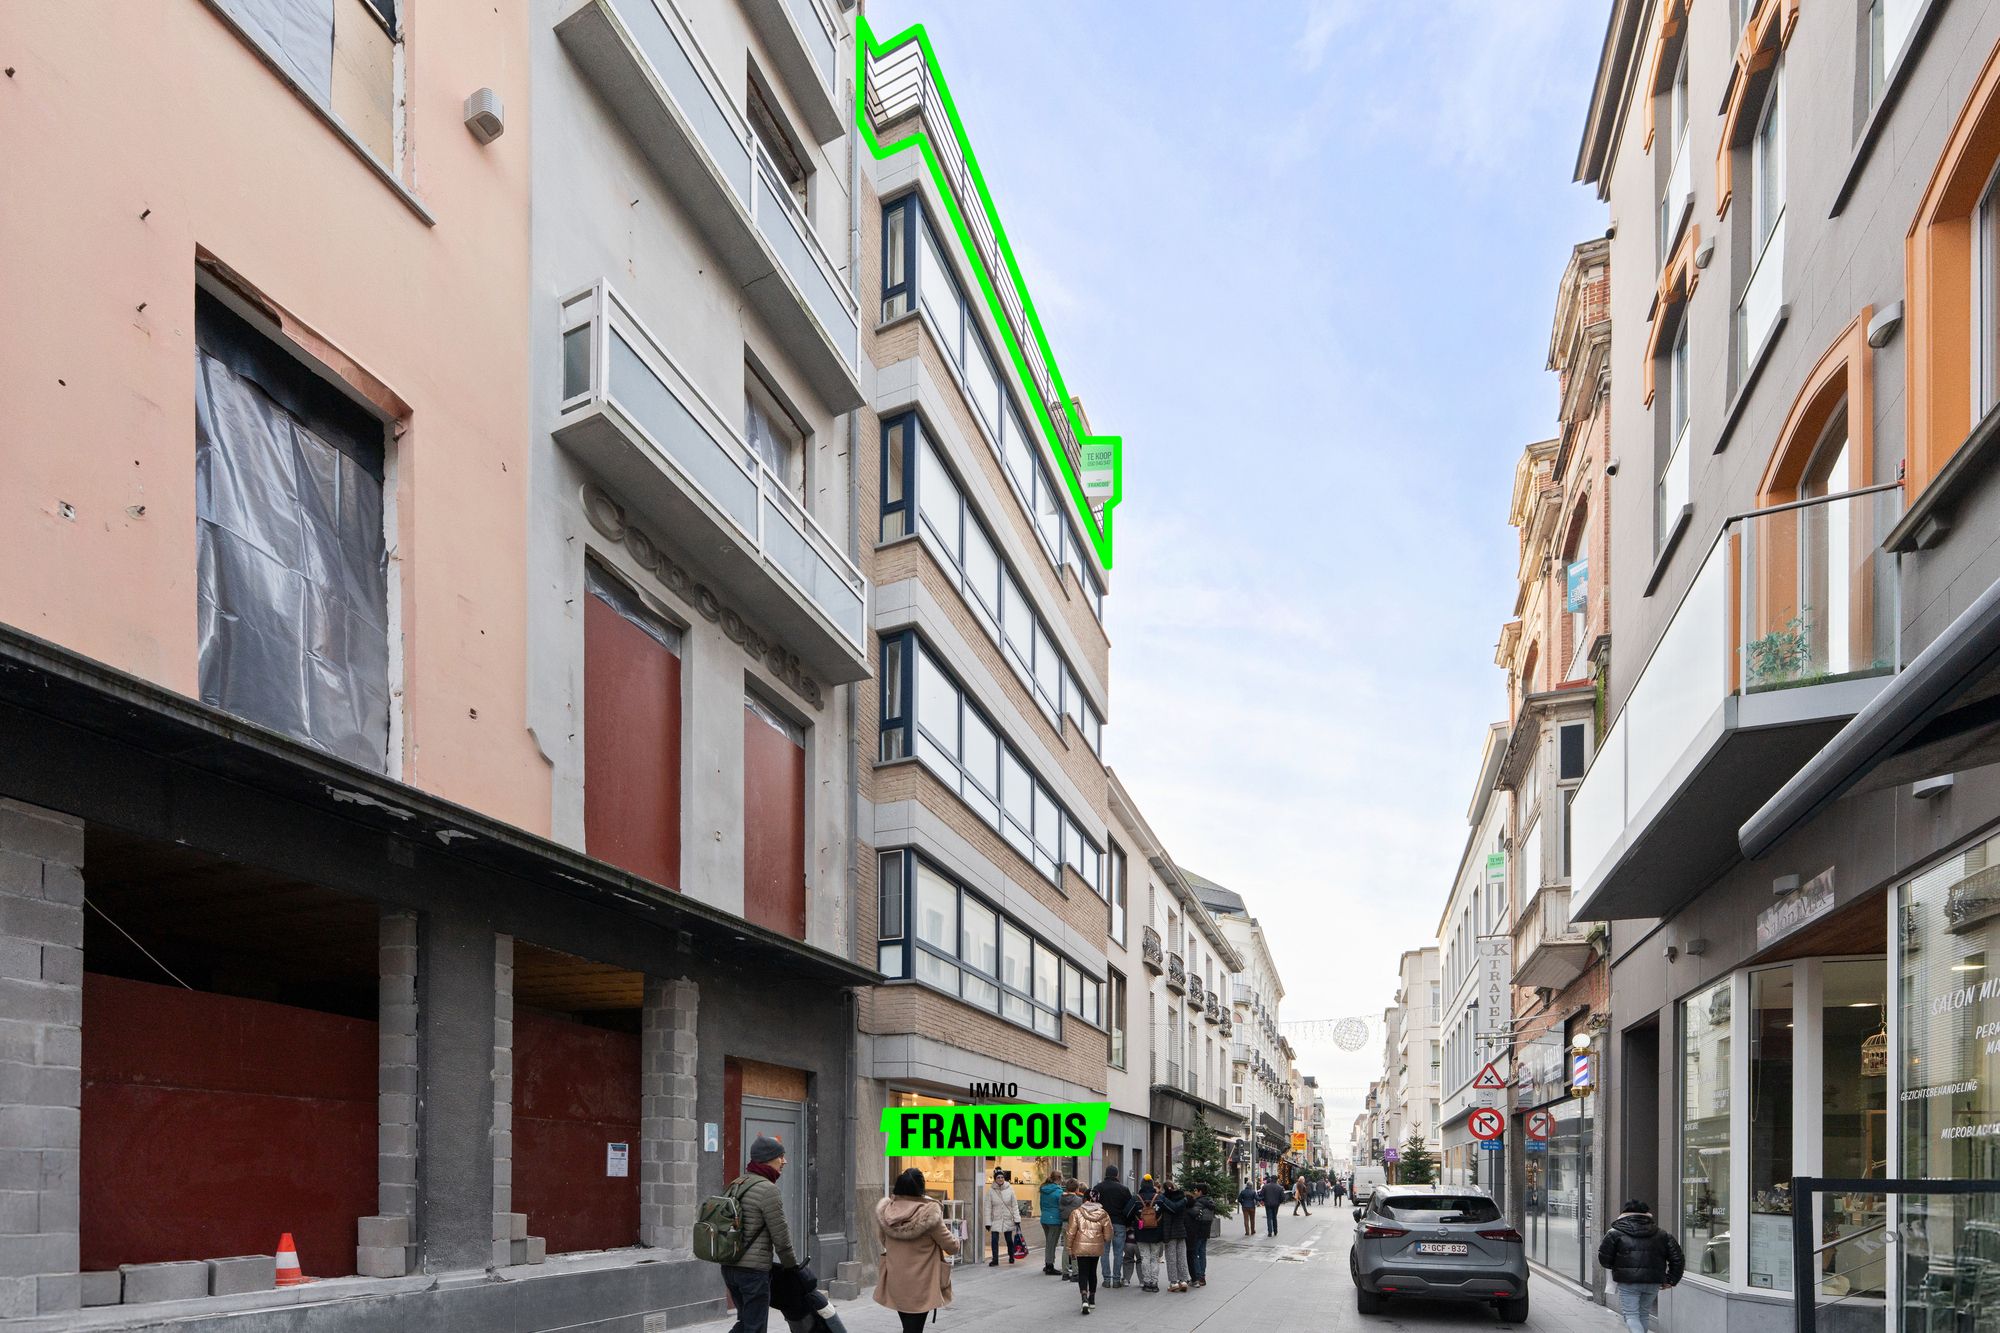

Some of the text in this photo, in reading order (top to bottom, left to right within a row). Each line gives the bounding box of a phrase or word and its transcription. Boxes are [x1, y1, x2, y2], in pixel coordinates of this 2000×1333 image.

[1087, 451, 1112, 461] TE KOOP
[1489, 960, 1501, 1028] TRAVEL
[1931, 984, 1975, 1016] SALON
[1901, 1081, 1977, 1101] GEZICHTSBEHANDELING
